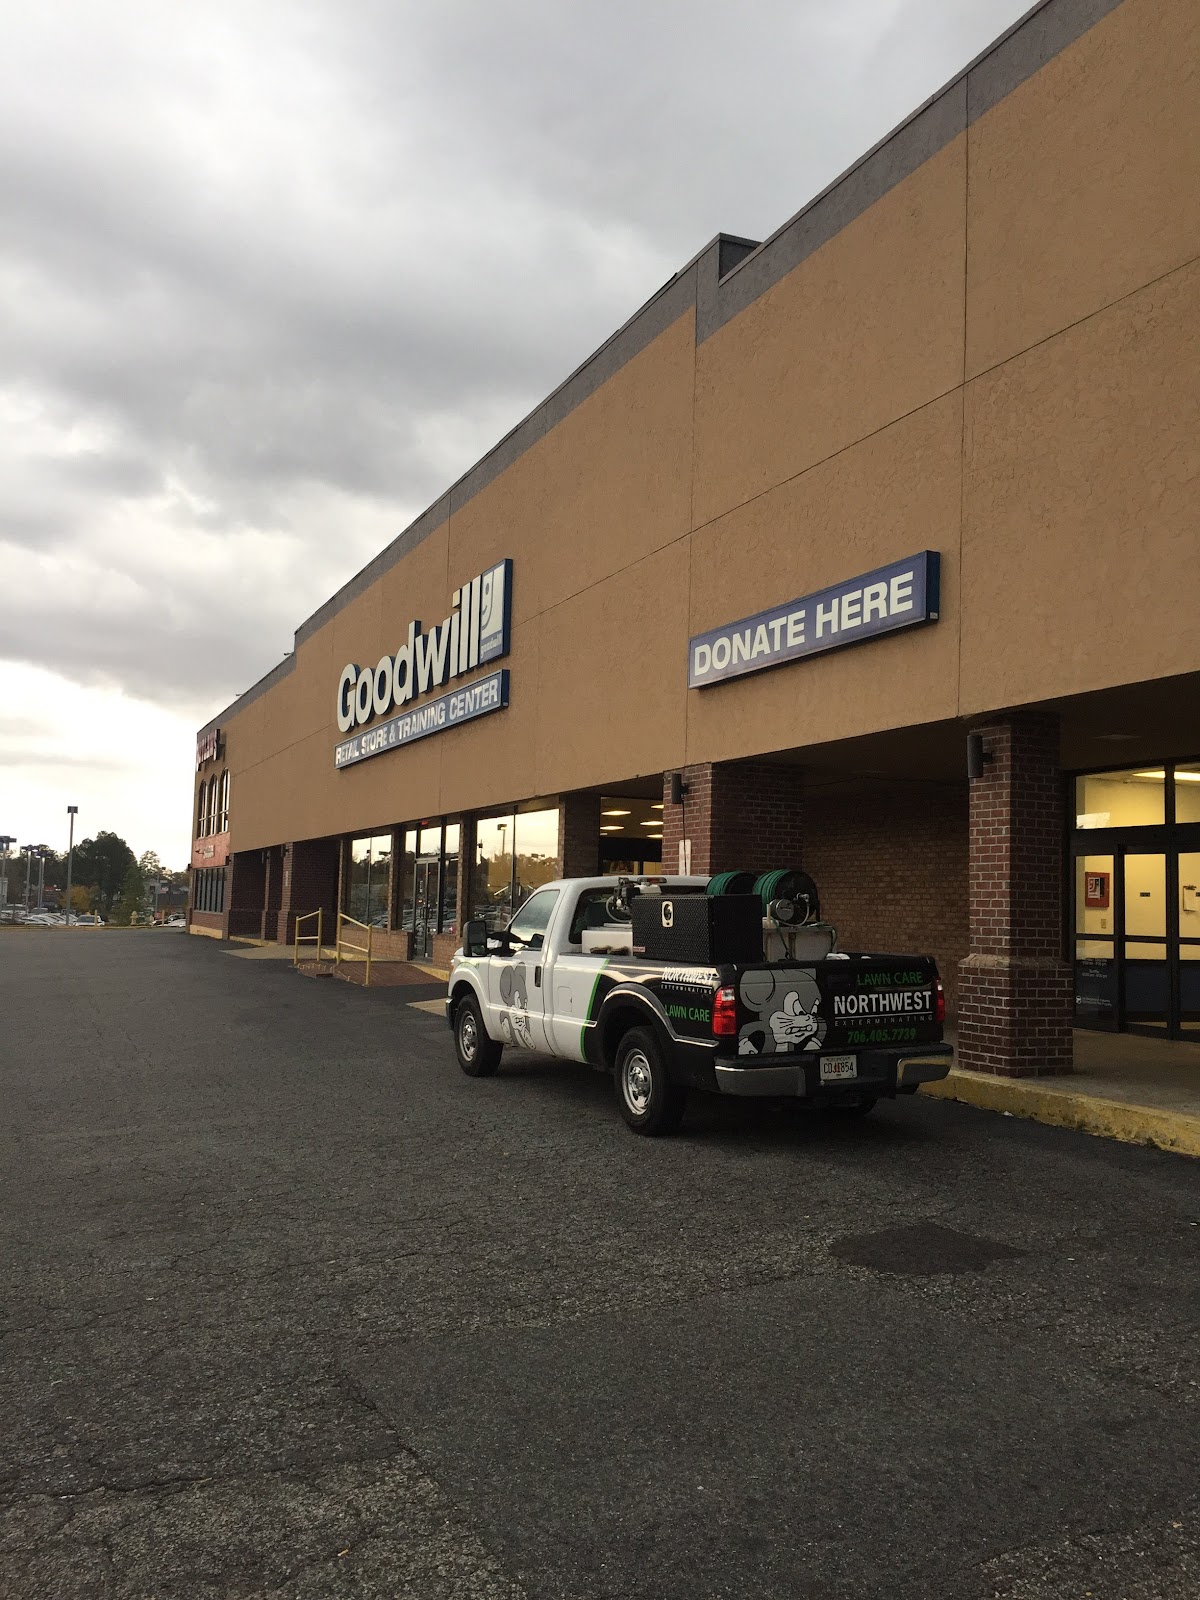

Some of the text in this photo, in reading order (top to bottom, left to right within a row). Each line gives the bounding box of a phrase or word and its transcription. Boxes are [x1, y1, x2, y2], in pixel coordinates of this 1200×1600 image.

[694, 571, 914, 676] DONATE HERE
[337, 574, 481, 732] Goodwill
[335, 678, 498, 764] RETAIL STORE & TRAINING CENTER
[661, 967, 713, 986] NORTHWEST
[857, 971, 924, 986] LAWN CARE
[660, 984, 712, 995] EXTERMINATING
[834, 991, 932, 1014] NORTHWEST
[665, 1004, 711, 1022] LAWN CARE
[835, 1015, 933, 1027] EXTERMINATING
